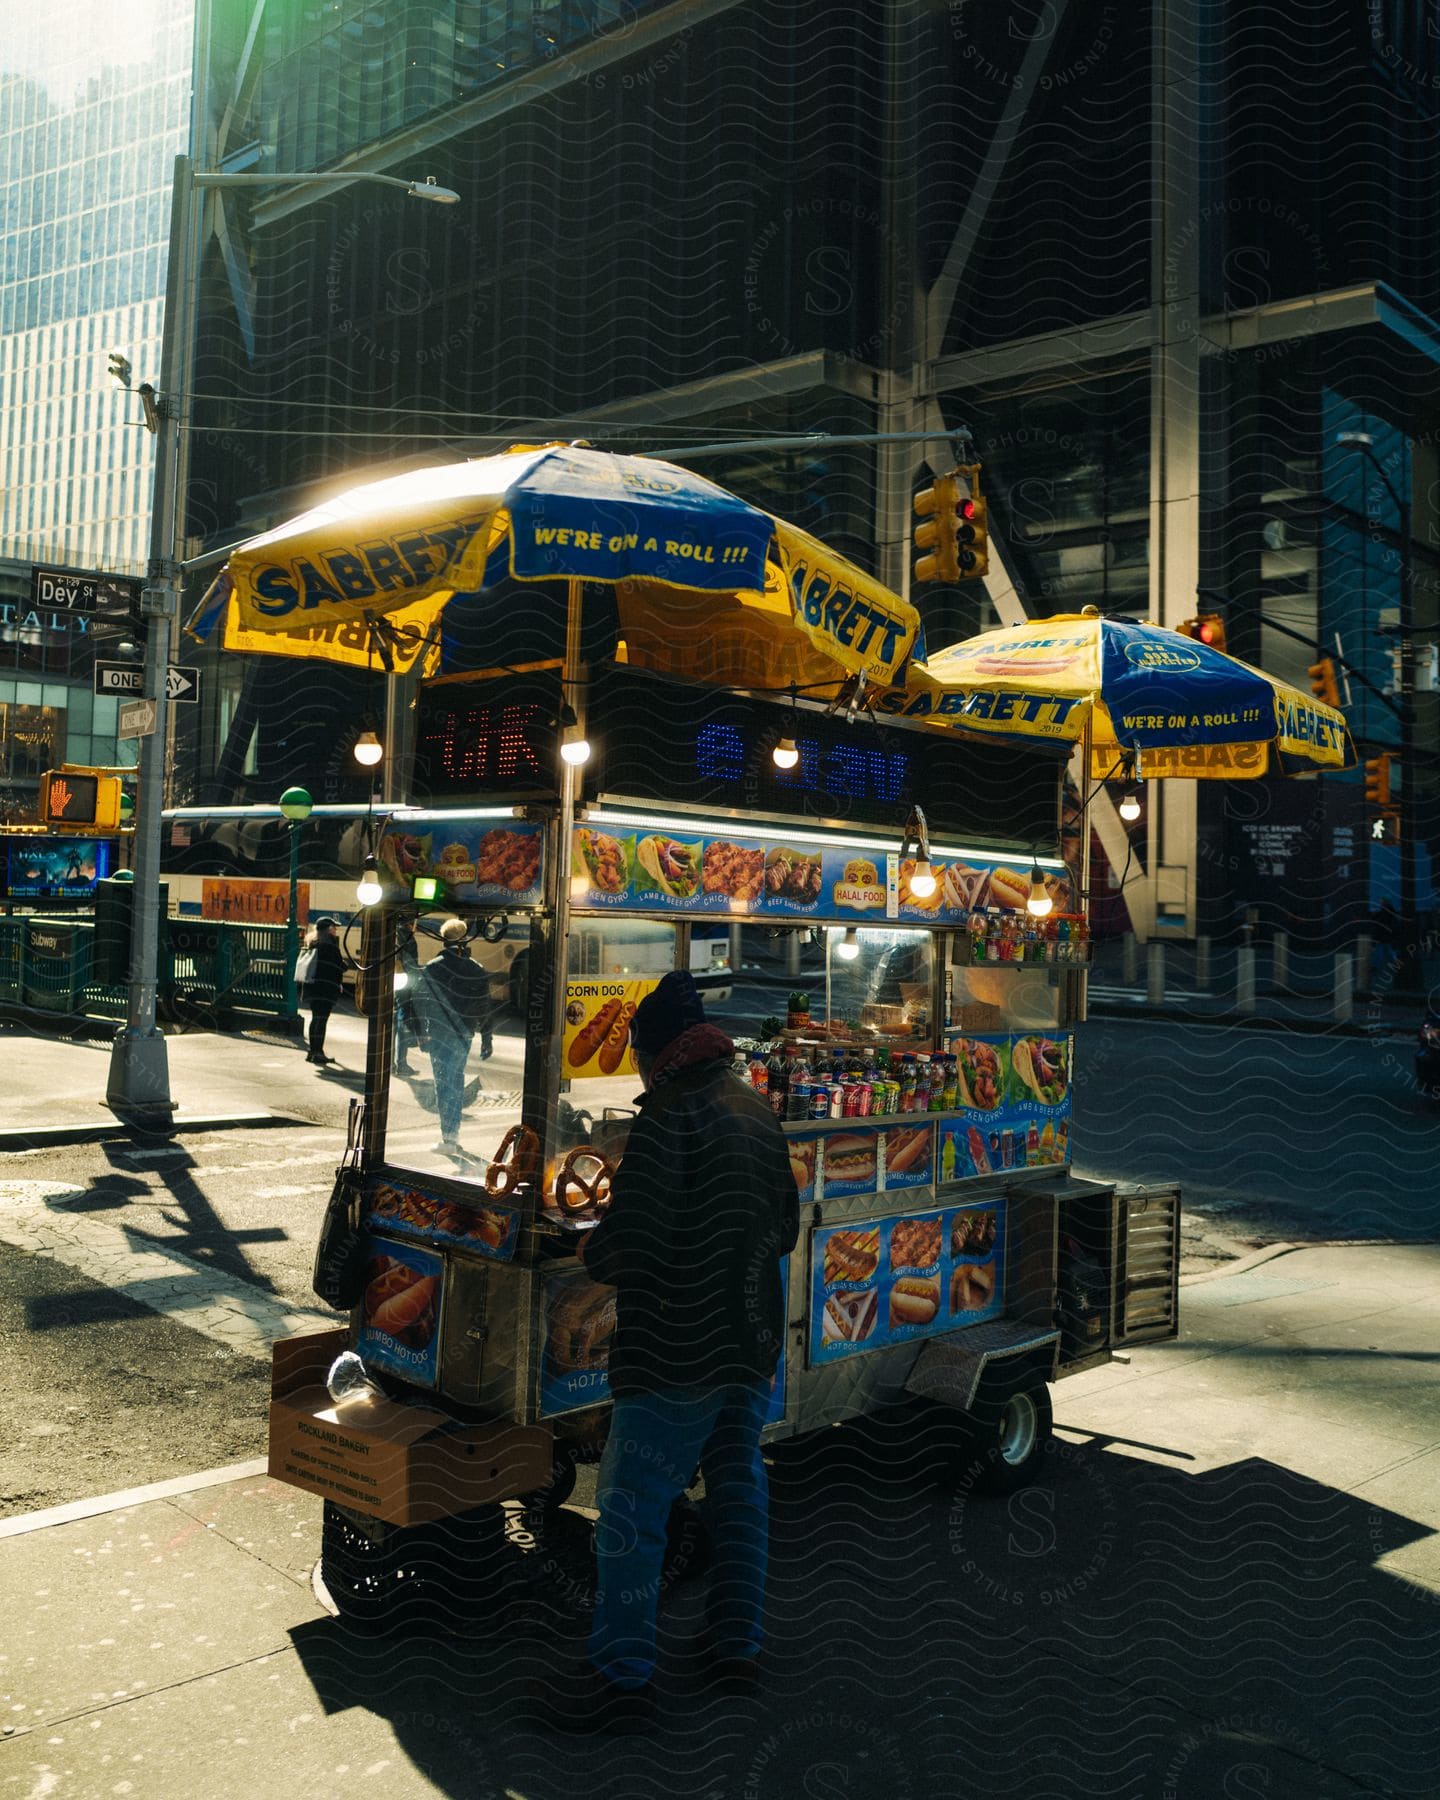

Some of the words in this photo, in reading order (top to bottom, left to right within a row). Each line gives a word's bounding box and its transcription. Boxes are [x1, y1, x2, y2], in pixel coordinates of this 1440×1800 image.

[535, 528, 603, 550] WE'RE
[608, 534, 639, 553] ON
[644, 537, 658, 551] A
[665, 540, 715, 564] ROLL
[722, 547, 749, 563] !!!
[42, 580, 77, 608] Dey
[83, 586, 94, 597] St
[868, 662, 890, 678] 2017
[111, 672, 140, 687] ONE
[166, 677, 182, 691] AY
[876, 688, 1083, 725] SABRETT
[1040, 724, 1062, 734] 2019
[1123, 716, 1164, 730] WE'RE
[1167, 714, 1186, 729] ON
[1190, 715, 1200, 727] A
[1203, 712, 1239, 727] ROLL
[1243, 709, 1260, 723] !!!
[455, 868, 475, 879] FOOD
[607, 891, 629, 904] GYRO
[639, 892, 659, 902] LAMB
[666, 896, 683, 908] BEEF
[684, 893, 701, 908] GYRO
[836, 889, 862, 900] HALAL
[863, 891, 885, 902] FOOD
[767, 898, 783, 908] BEEF
[801, 900, 819, 914] KEBAB
[30, 931, 58, 950] Subway
[566, 985, 599, 997] CORN
[602, 985, 625, 997] DOG
[984, 1105, 1005, 1124] GYRO
[365, 1329, 393, 1348] JUMBO
[394, 1342, 411, 1360] HOT
[411, 1349, 429, 1365] DOG
[828, 1341, 841, 1351] HOT
[842, 1342, 857, 1351] DOG
[568, 1373, 597, 1393] HOT
[297, 1421, 338, 1444] ROCKLAND
[338, 1435, 371, 1456] BAKERY
